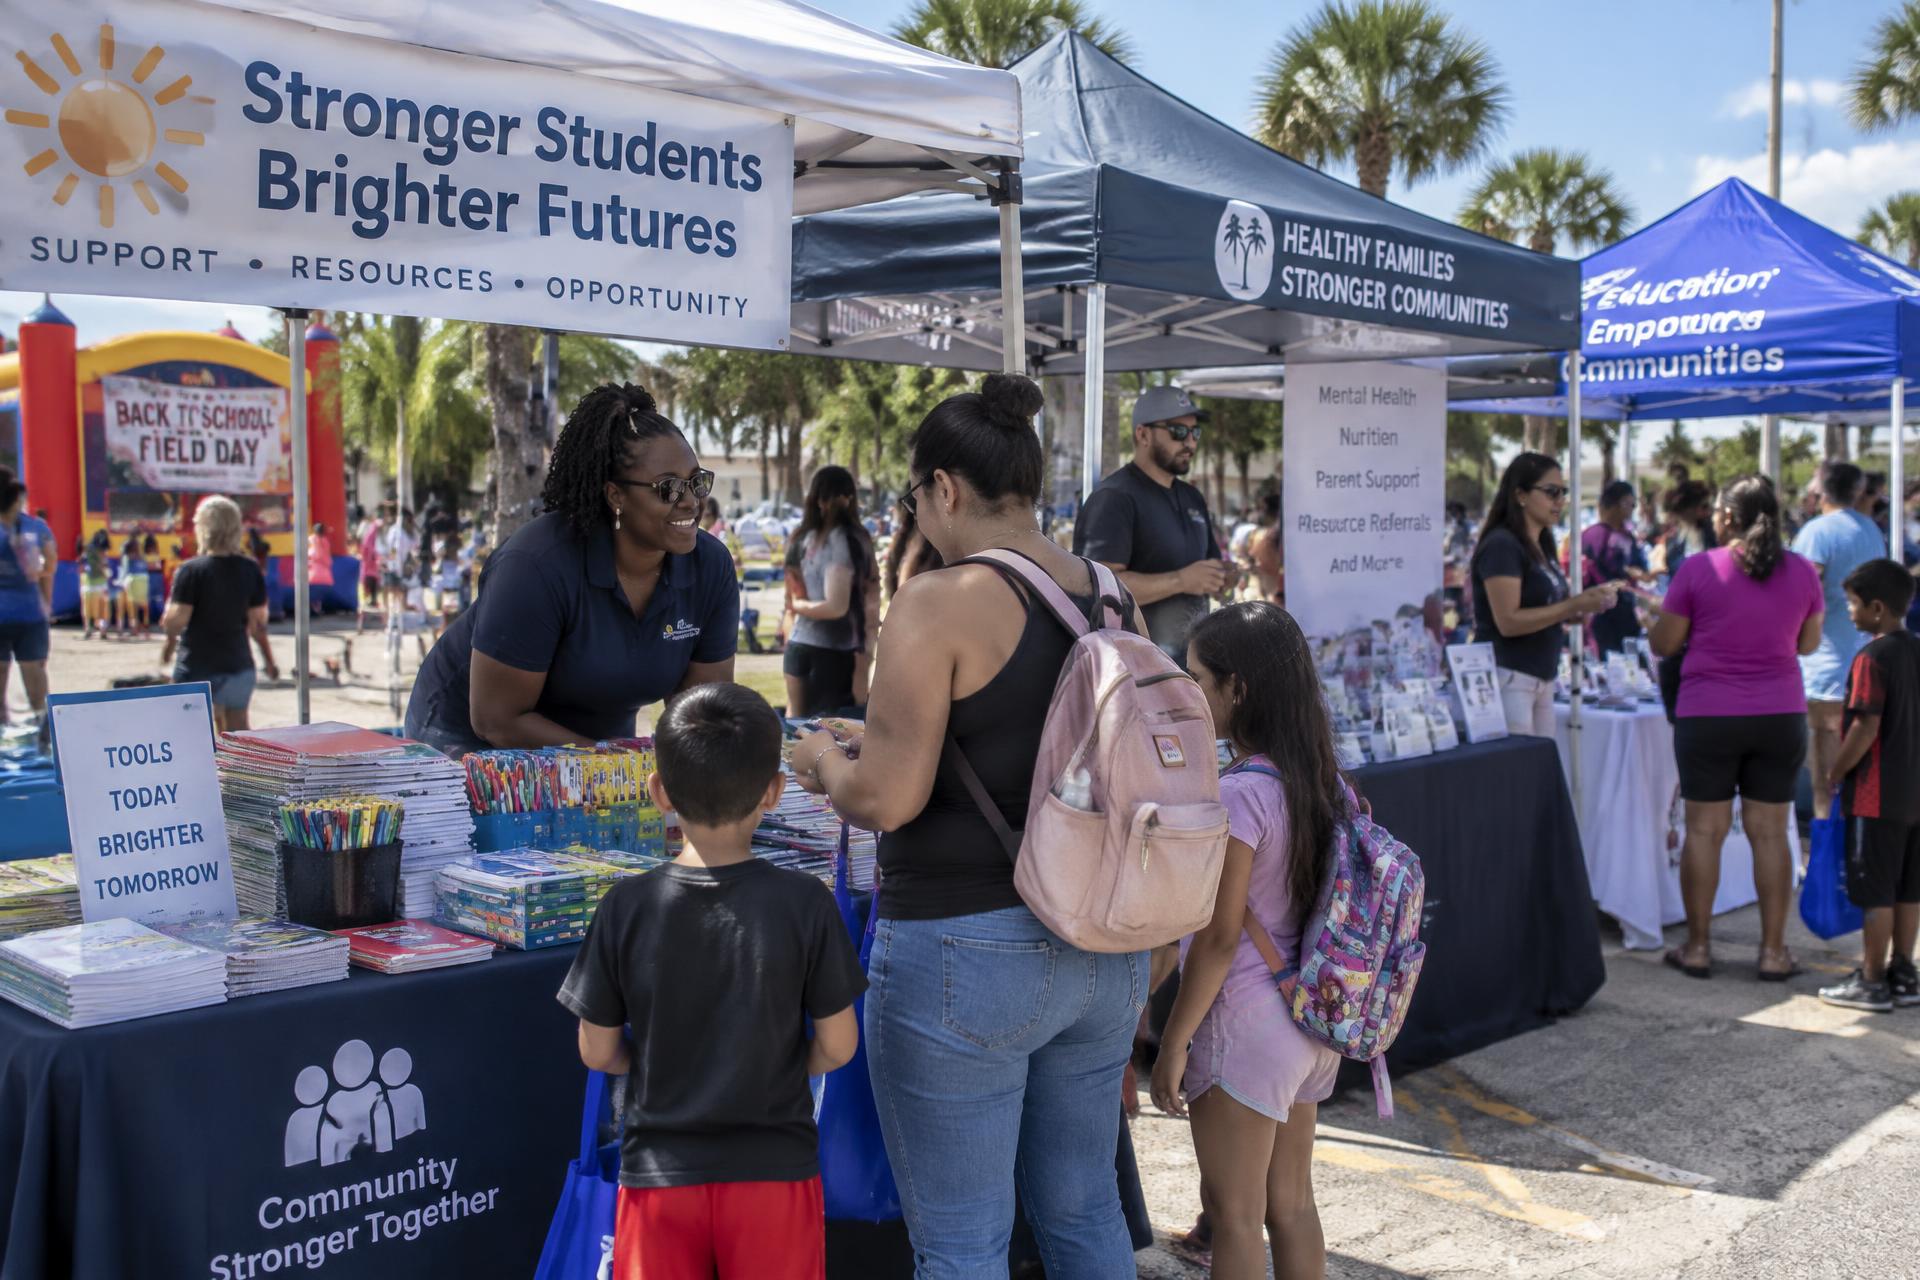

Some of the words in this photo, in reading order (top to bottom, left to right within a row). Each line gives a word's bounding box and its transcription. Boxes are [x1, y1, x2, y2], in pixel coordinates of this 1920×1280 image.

[243, 60, 521, 166] Stronger
[534, 105, 763, 193] Students
[257, 148, 519, 240] Brighter
[538, 182, 737, 259] Futures
[1283, 221, 1371, 266] HEALTHY
[1375, 239, 1455, 282] FAMILIES
[30, 235, 218, 274] SUPPORT
[291, 254, 493, 293] RESOURCES
[546, 276, 749, 319] OPPORTUNITY
[1281, 265, 1386, 310] STRONGER
[1391, 283, 1509, 329] COMMUNITIES
[1319, 386, 1367, 405] Mental
[116, 401, 170, 428] BACK
[140, 435, 206, 463] FIELD
[215, 438, 260, 467] DAY
[1316, 470, 1362, 489] Parent
[1330, 555, 1358, 573] And
[104, 741, 173, 768] TOOLS
[110, 783, 179, 811] TODAY
[99, 823, 204, 857] BRIGHTER
[94, 861, 220, 900] TOMORROW
[258, 1157, 457, 1229] Community
[210, 1225, 359, 1280] Stronger
[365, 1186, 499, 1241] Together
